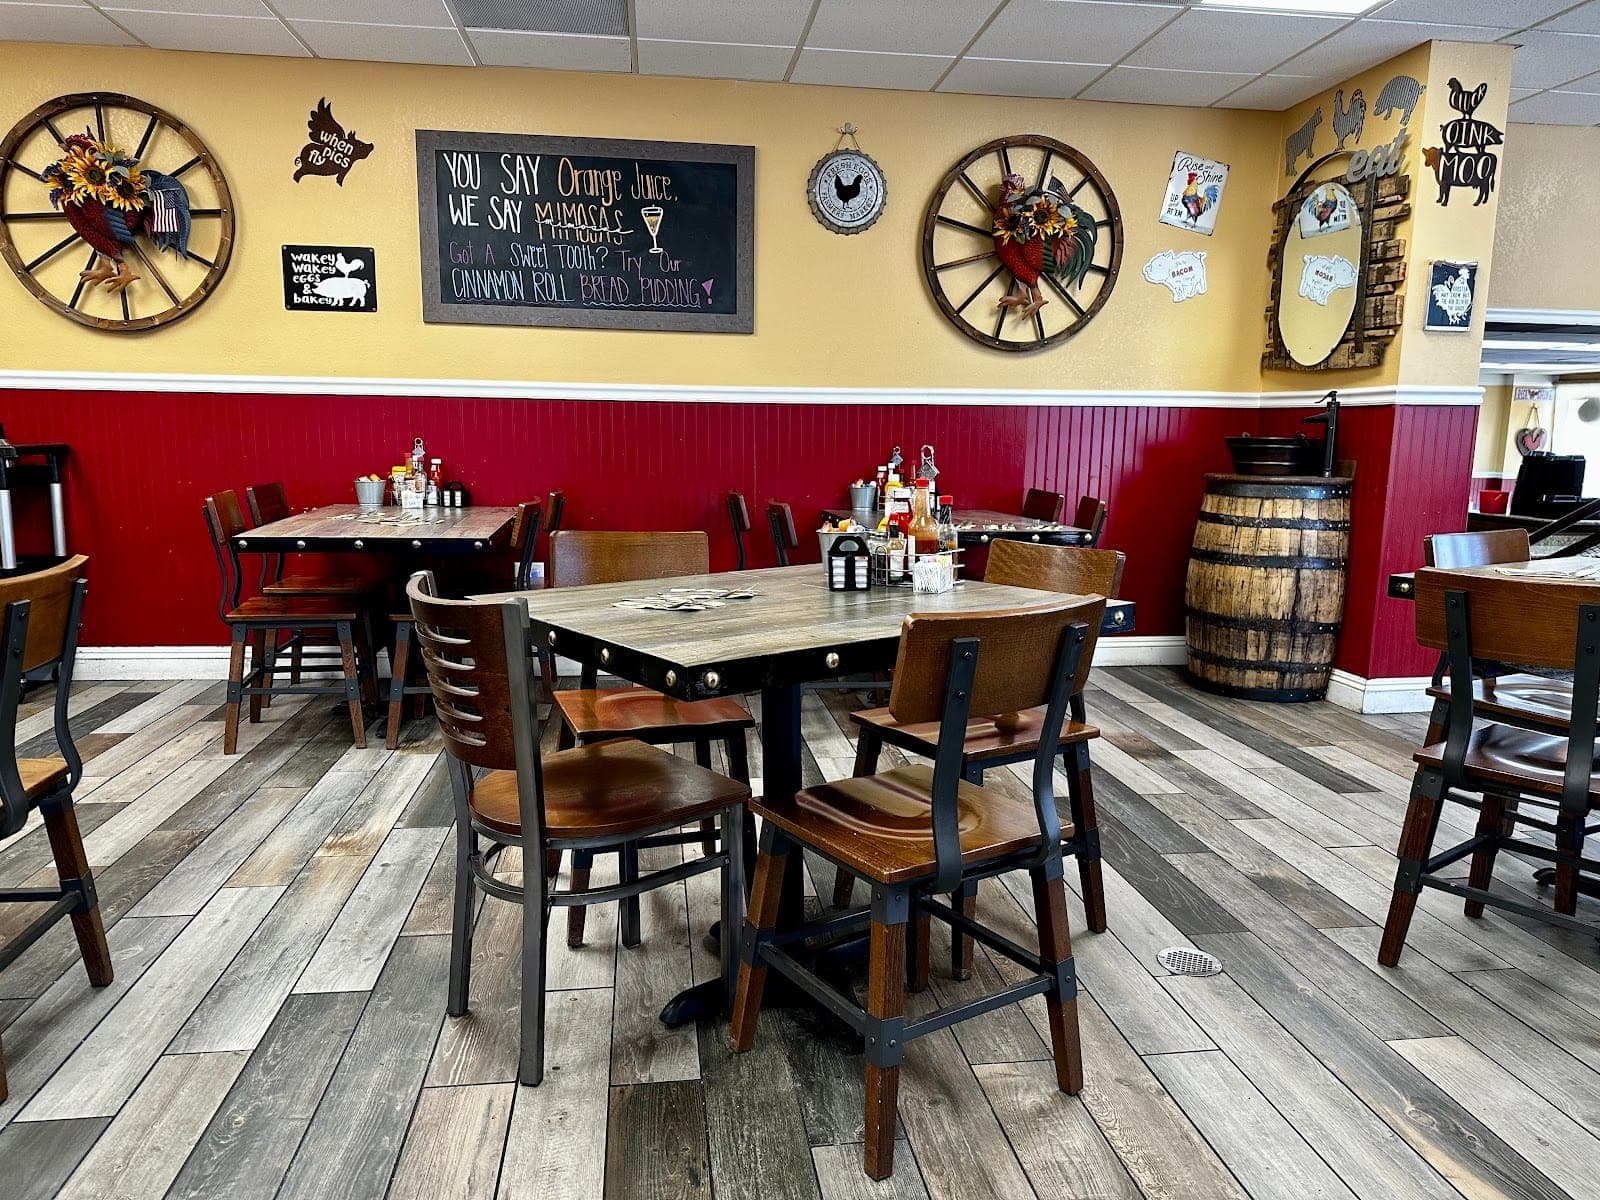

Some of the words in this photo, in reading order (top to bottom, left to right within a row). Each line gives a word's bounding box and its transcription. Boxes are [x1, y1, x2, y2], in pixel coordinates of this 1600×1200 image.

[1451, 84, 1486, 111] CLUCK
[320, 130, 354, 155] when
[1445, 121, 1495, 146] OINK
[308, 150, 326, 165] fly
[1177, 157, 1204, 172] Rise
[1347, 127, 1408, 183] eat
[443, 152, 481, 190] YOU
[500, 153, 541, 195] SAY
[558, 157, 622, 206] Orange
[631, 162, 678, 202] Juice,
[826, 162, 851, 178] FRESH
[853, 162, 873, 184] EGGS
[1196, 170, 1223, 185] Shine
[1439, 154, 1492, 184] MOO
[849, 198, 873, 219] MARKET
[1170, 192, 1179, 203] UP
[449, 193, 480, 227] WE
[488, 195, 523, 233] SAY
[534, 201, 624, 246] MIMOSAS
[449, 240, 475, 266] Got
[485, 243, 496, 266] A
[510, 242, 549, 270] Sweet
[612, 249, 642, 280] Try
[659, 251, 682, 273] Our
[1171, 266, 1194, 278] BACON
[302, 283, 312, 294] &
[451, 268, 524, 301] CINNAMON
[533, 271, 575, 303] ROLL
[580, 275, 629, 304] BREAD
